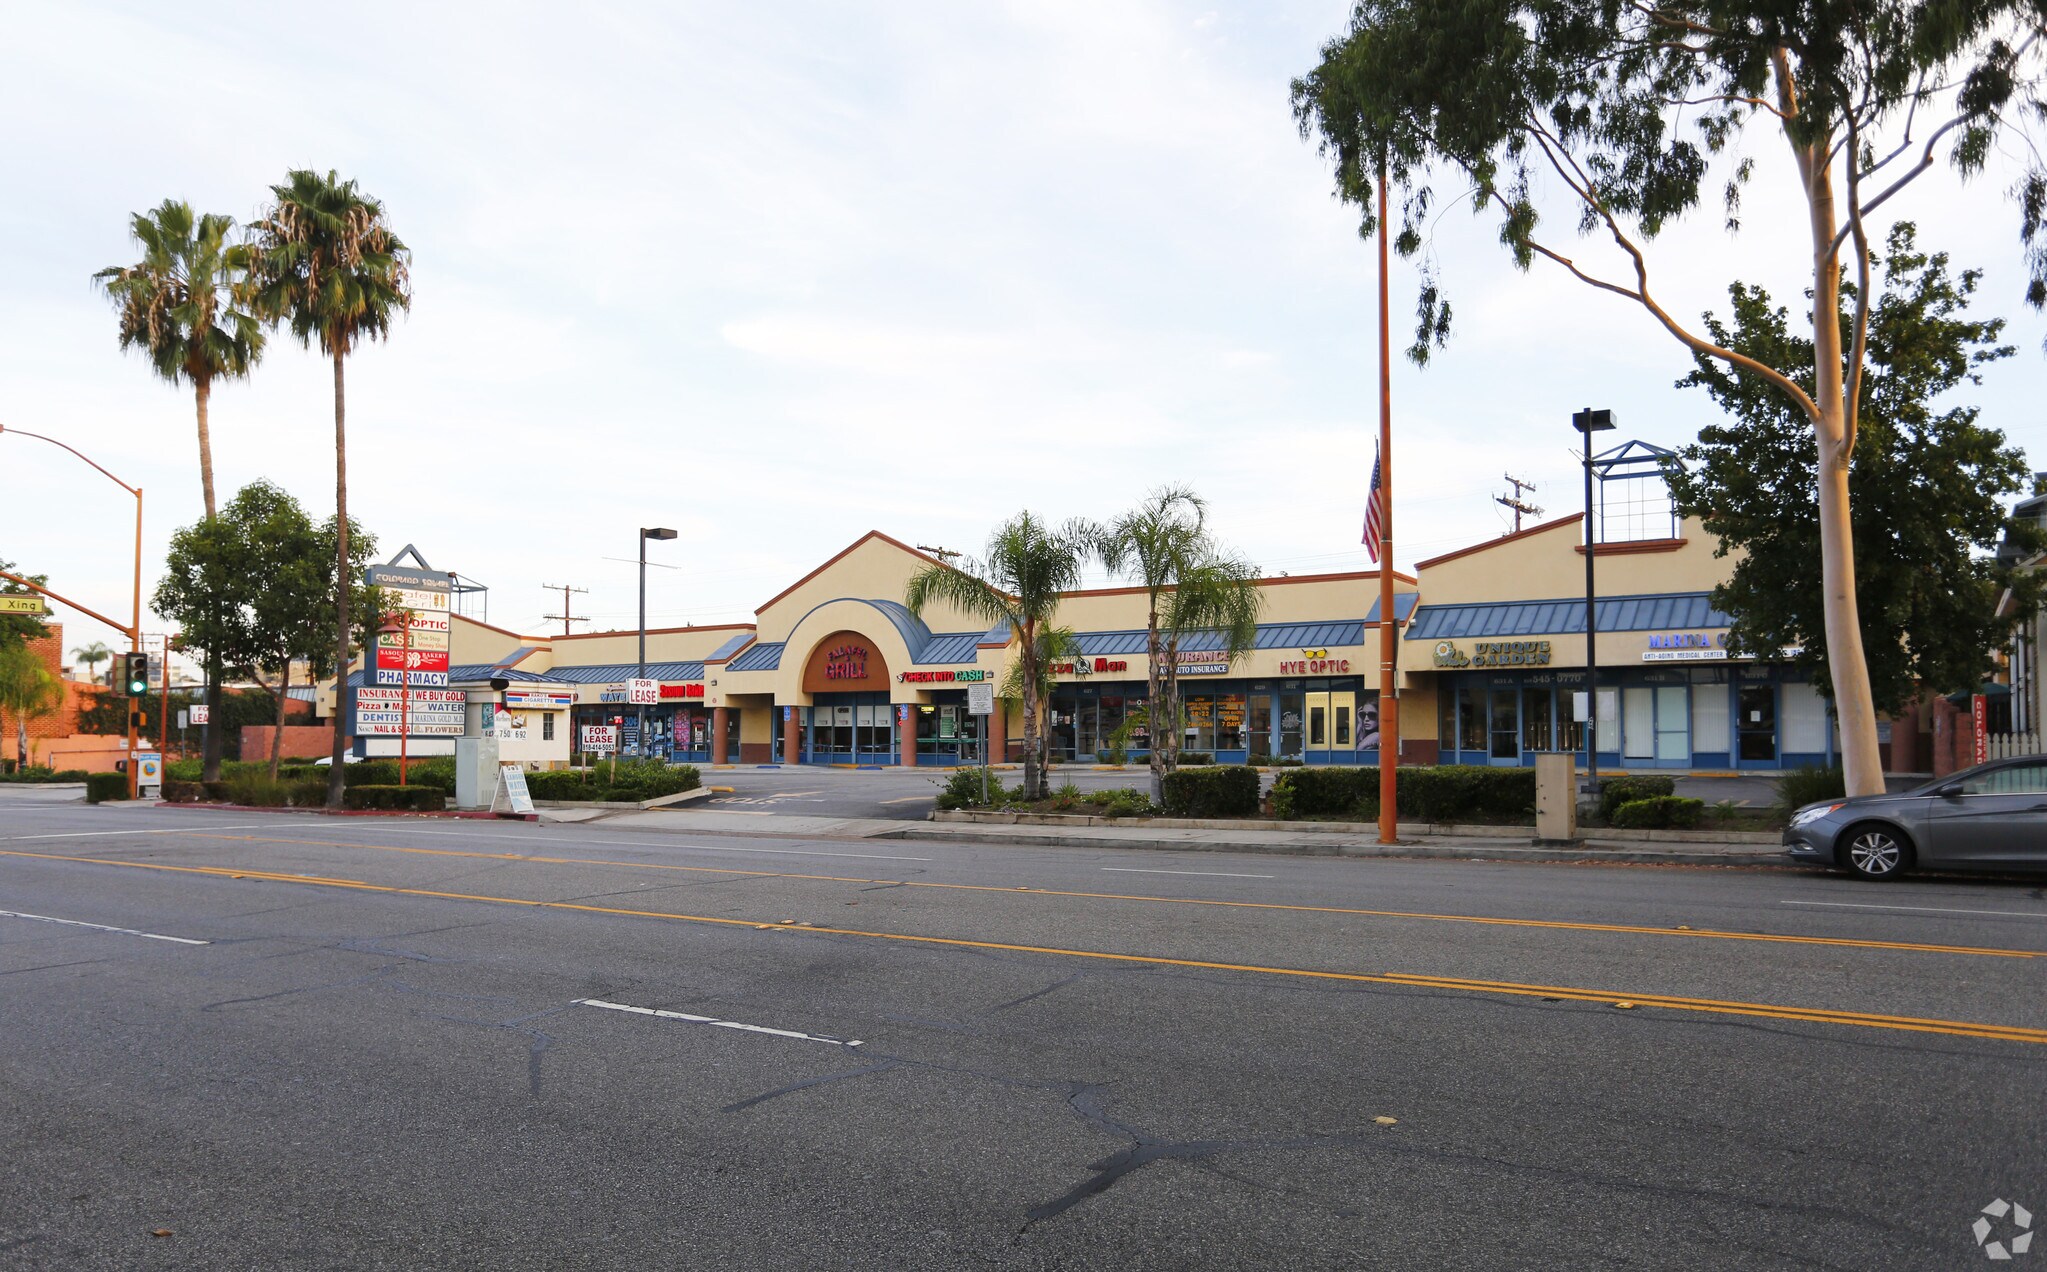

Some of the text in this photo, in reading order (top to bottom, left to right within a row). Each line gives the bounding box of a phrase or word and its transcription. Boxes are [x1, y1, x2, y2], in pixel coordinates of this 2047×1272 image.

[8, 600, 35, 610] Xing
[411, 619, 447, 630] OPTIC
[1649, 633, 1711, 648] MARINA
[1475, 641, 1550, 654] UNIQUE
[1095, 657, 1127, 672] Man
[1472, 653, 1551, 666] GARDEN
[825, 661, 868, 679] GRILL
[1191, 664, 1227, 673] INSURANCE
[1280, 659, 1350, 674] HYE OPTIC
[379, 671, 446, 685] PHARMACY
[905, 672, 933, 683] CHECK
[935, 671, 954, 682] INTO
[635, 680, 651, 688] FOR
[415, 691, 465, 701] WE BUY GOLD
[630, 690, 657, 704] LEASE
[357, 702, 381, 710] Pizza
[428, 703, 464, 711] WATER
[374, 725, 389, 733] NAIL
[515, 730, 526, 738] 692
[589, 727, 608, 735] FOR
